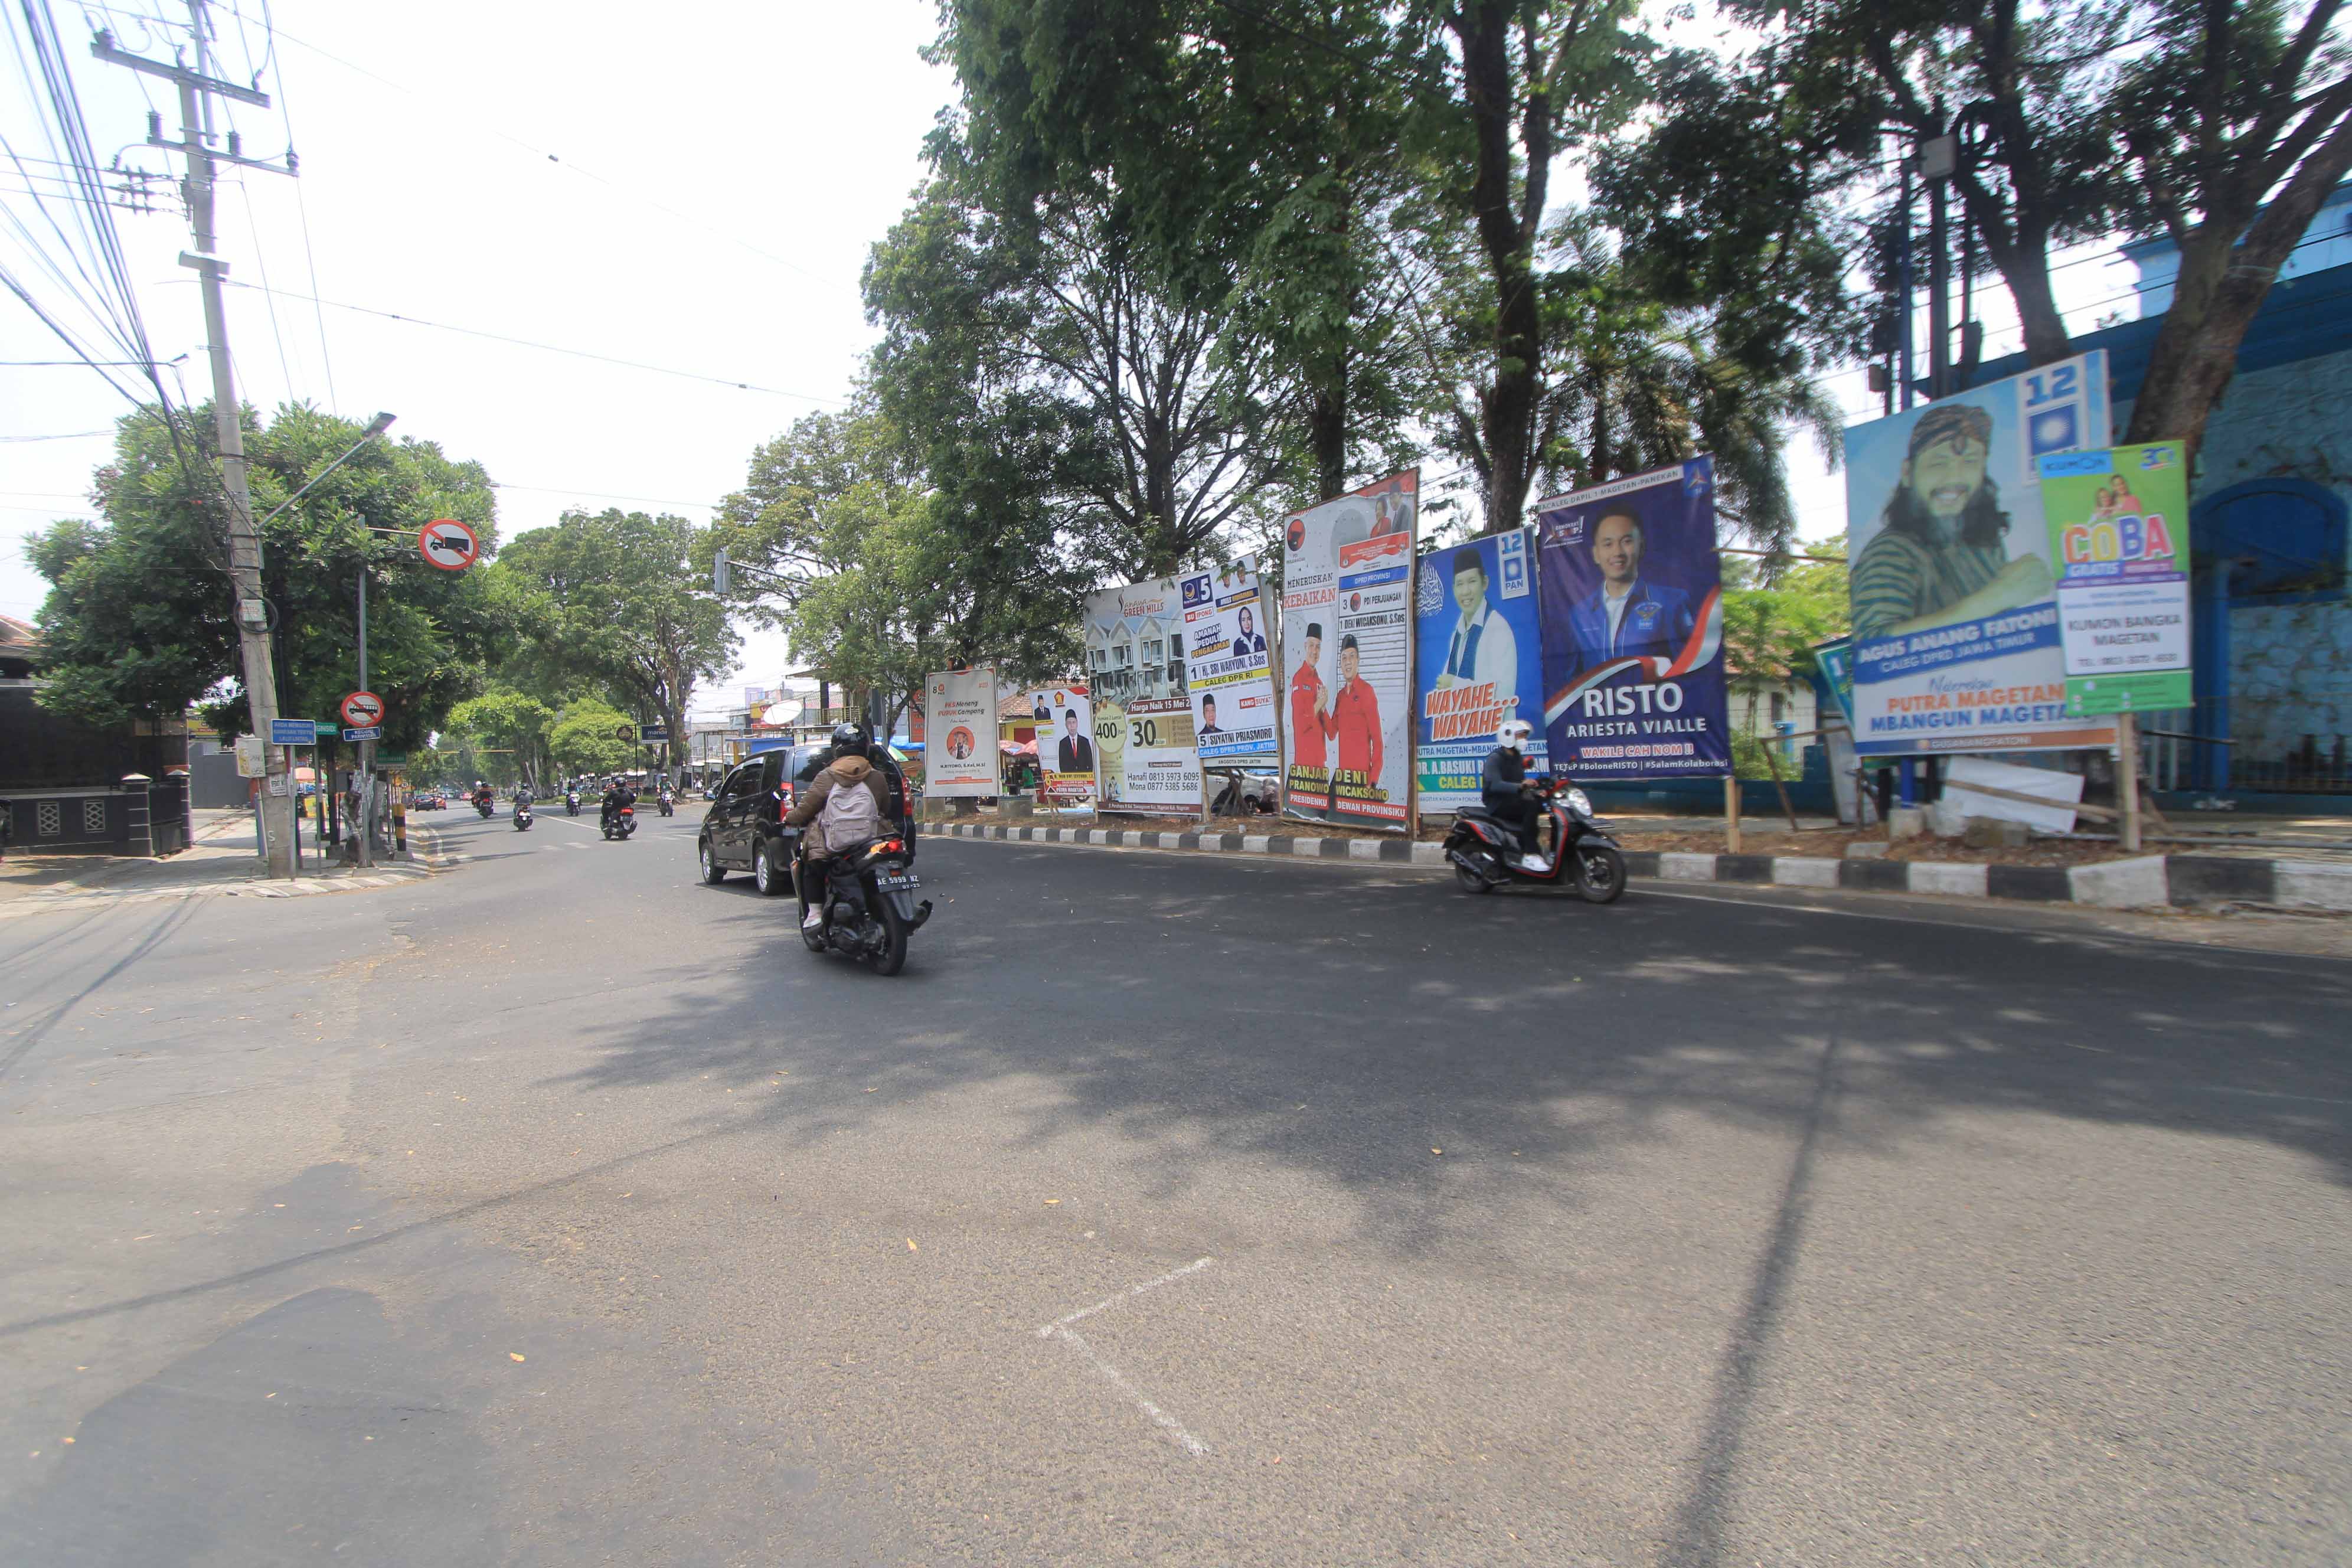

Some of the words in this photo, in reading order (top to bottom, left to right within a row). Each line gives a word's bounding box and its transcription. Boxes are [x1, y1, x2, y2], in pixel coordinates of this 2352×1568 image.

[2026, 364, 2079, 407] 12
[1571, 492, 1592, 504] DAPIL
[1600, 471, 1678, 496] MAGETAN-PANEKAN
[1501, 533, 1523, 555] 12
[2063, 513, 2175, 563] COBA
[1287, 572, 1334, 589] MENERUSKAN
[1368, 571, 1391, 582] PROVINSI
[1200, 577, 1211, 601] 5
[1506, 579, 1524, 591] PAN
[1284, 587, 1337, 609] KEBAIKAN
[1342, 599, 1348, 610] 3
[1371, 592, 1402, 605] PERJUANGAN
[1123, 604, 1145, 618] GREEN
[1146, 602, 1164, 615] HILLS
[1196, 609, 1213, 619] IPONG
[1344, 618, 1355, 629] DENI
[1389, 613, 1405, 624] S.Sos
[2068, 618, 2121, 631] KUMON
[2125, 614, 2181, 628] BANGKA
[1194, 623, 1222, 641] AMANAH
[1860, 641, 1906, 664] AGUS
[1910, 624, 1981, 652] ANANG
[1984, 609, 2058, 637] FATONI
[2093, 632, 2160, 645] MAGETAN
[1191, 638, 1230, 659] PENGALAMAN
[1197, 633, 1220, 648] PEDULI
[1881, 657, 1919, 673] CALEG
[1923, 650, 1953, 665] DPRD
[1956, 641, 1992, 658] JAWA
[1994, 633, 2036, 650] TIMUR
[1191, 667, 1197, 680] 1
[1210, 662, 1220, 675] SRI
[1220, 656, 1248, 672] WAHYUNI,
[1248, 654, 1266, 668] S.Sos
[1204, 677, 1227, 687] CALEG
[1228, 673, 1244, 682] DPR
[1240, 698, 1255, 707] KANG
[1256, 696, 1272, 704] SUYAT
[1583, 681, 1683, 718] RISTO
[1887, 692, 1949, 713] PUTRA
[1957, 683, 2064, 708] MAGETAN
[1131, 703, 1149, 713] Harga
[1149, 701, 1164, 711] Naik
[1165, 701, 1172, 709] 15
[1173, 700, 1185, 708] Mei
[1433, 708, 1503, 740] WAYAHE
[1870, 711, 1972, 732] MBANGUN
[1980, 704, 2079, 725] MAGETA
[1096, 722, 1118, 739] 400
[1132, 719, 1157, 748] 30
[1567, 721, 1637, 738] ARIESTA
[1642, 717, 1707, 734] VIALLE
[1200, 736, 1207, 747] 5
[1210, 732, 1234, 746] SUYATNI
[1236, 727, 1273, 743] PRIASMORO
[1200, 747, 1219, 756] CALEG
[1220, 745, 1236, 754] DPRD
[1237, 743, 1256, 752] PROV.
[1256, 741, 1276, 750] JATIM
[1436, 744, 1502, 755] MAGETAN-MBANG
[1580, 745, 1623, 759] WAKILE
[1625, 744, 1651, 757] CAH
[1652, 743, 1683, 756] NOM
[1289, 764, 1329, 780] GANJAR
[1432, 760, 1475, 775] A.BASUKI
[1580, 761, 1638, 770] #BoloneRISTO
[1646, 758, 1729, 769] #SalamKolaborasi
[1127, 772, 1148, 781] Hanafi
[1149, 772, 1164, 782] 0813
[1166, 772, 1181, 782] 5973
[1183, 772, 1200, 782] 6095
[1335, 769, 1368, 785] DENI
[1439, 775, 1476, 789] CALEG
[1129, 782, 1146, 791] Mona
[1147, 782, 1163, 791] 0877
[1165, 782, 1180, 791] 5385
[1181, 782, 1198, 791] 5686
[1289, 779, 1329, 793] PRANOWO
[1335, 785, 1389, 801] WICAKSONO
[1290, 794, 1328, 807] PRESIDENKU
[1337, 801, 1361, 812] DEWAN
[1362, 803, 1406, 818] PROVINSIKU
[888, 876, 907, 884] 5999
